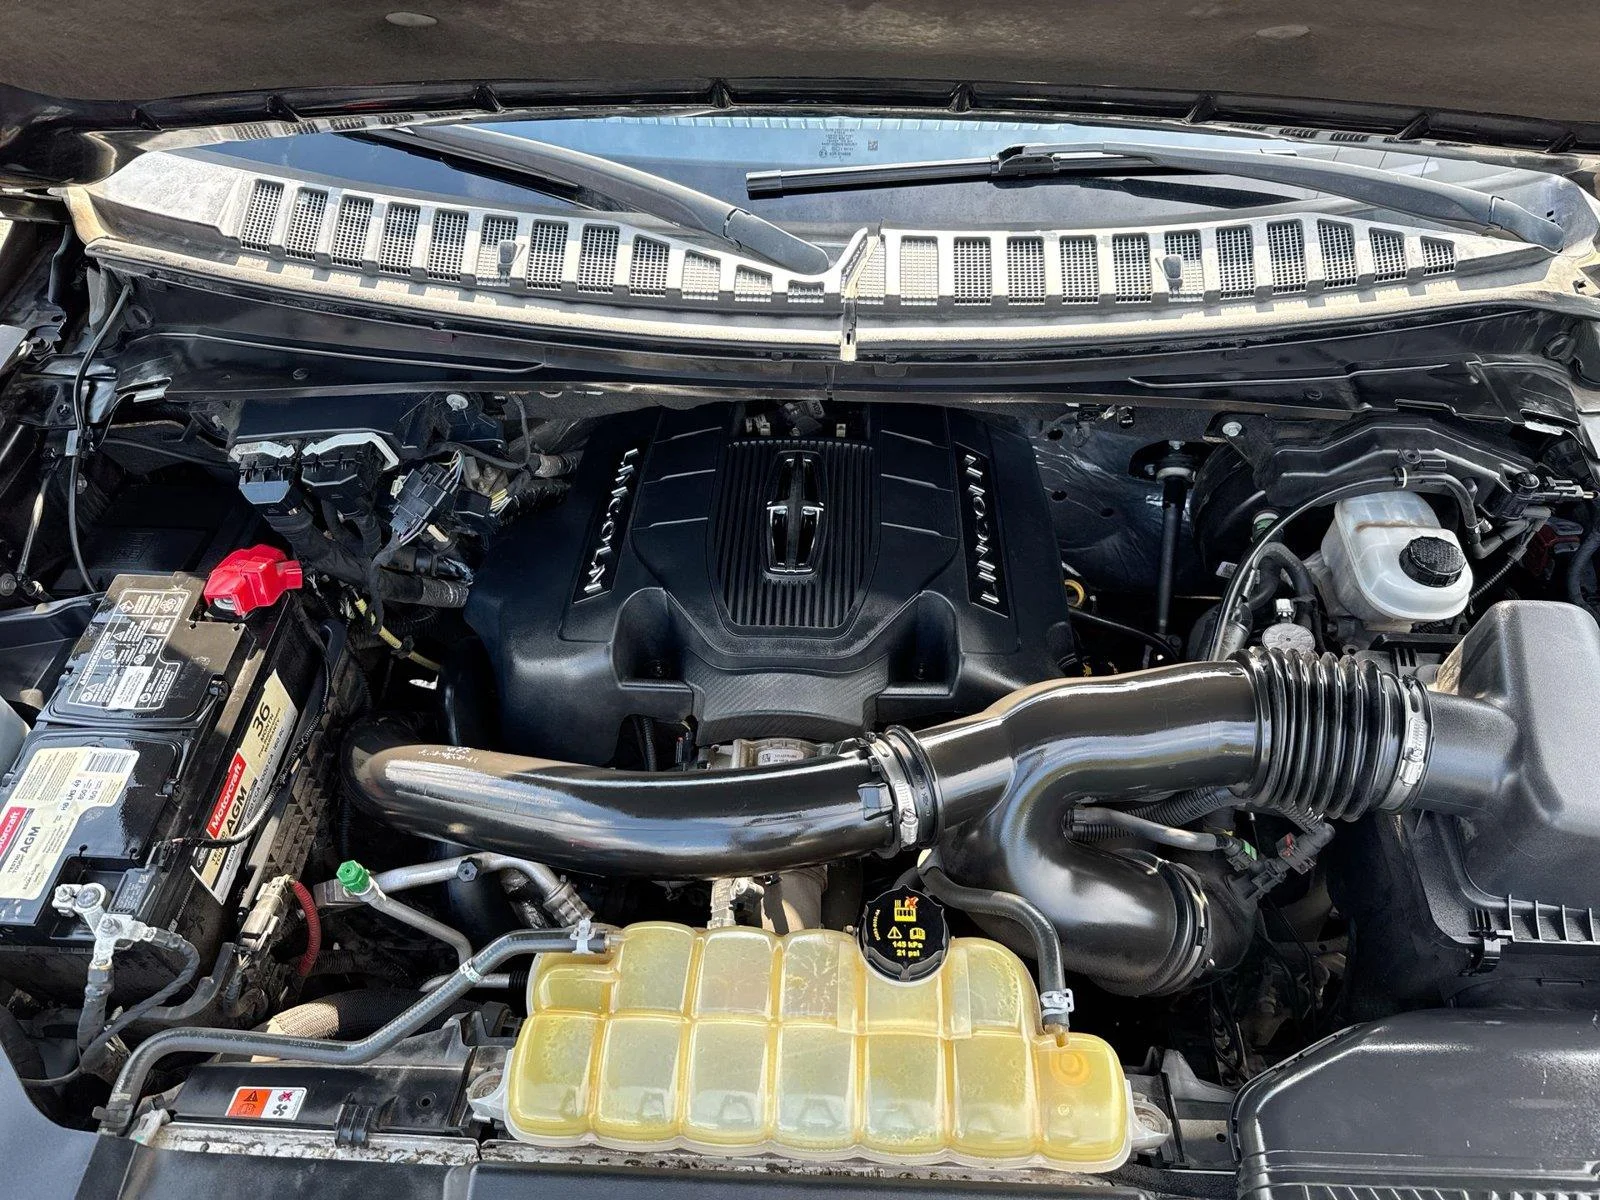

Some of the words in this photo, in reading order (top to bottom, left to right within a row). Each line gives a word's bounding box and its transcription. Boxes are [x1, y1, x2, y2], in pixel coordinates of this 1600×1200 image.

[584, 448, 638, 594] LINCOLN
[965, 454, 1000, 605] LINCOLN
[251, 704, 271, 736] 36
[259, 712, 274, 741] MONTH
[209, 761, 243, 829] Motorcraft
[225, 784, 248, 834] AGM
[19, 825, 41, 854] AGM
